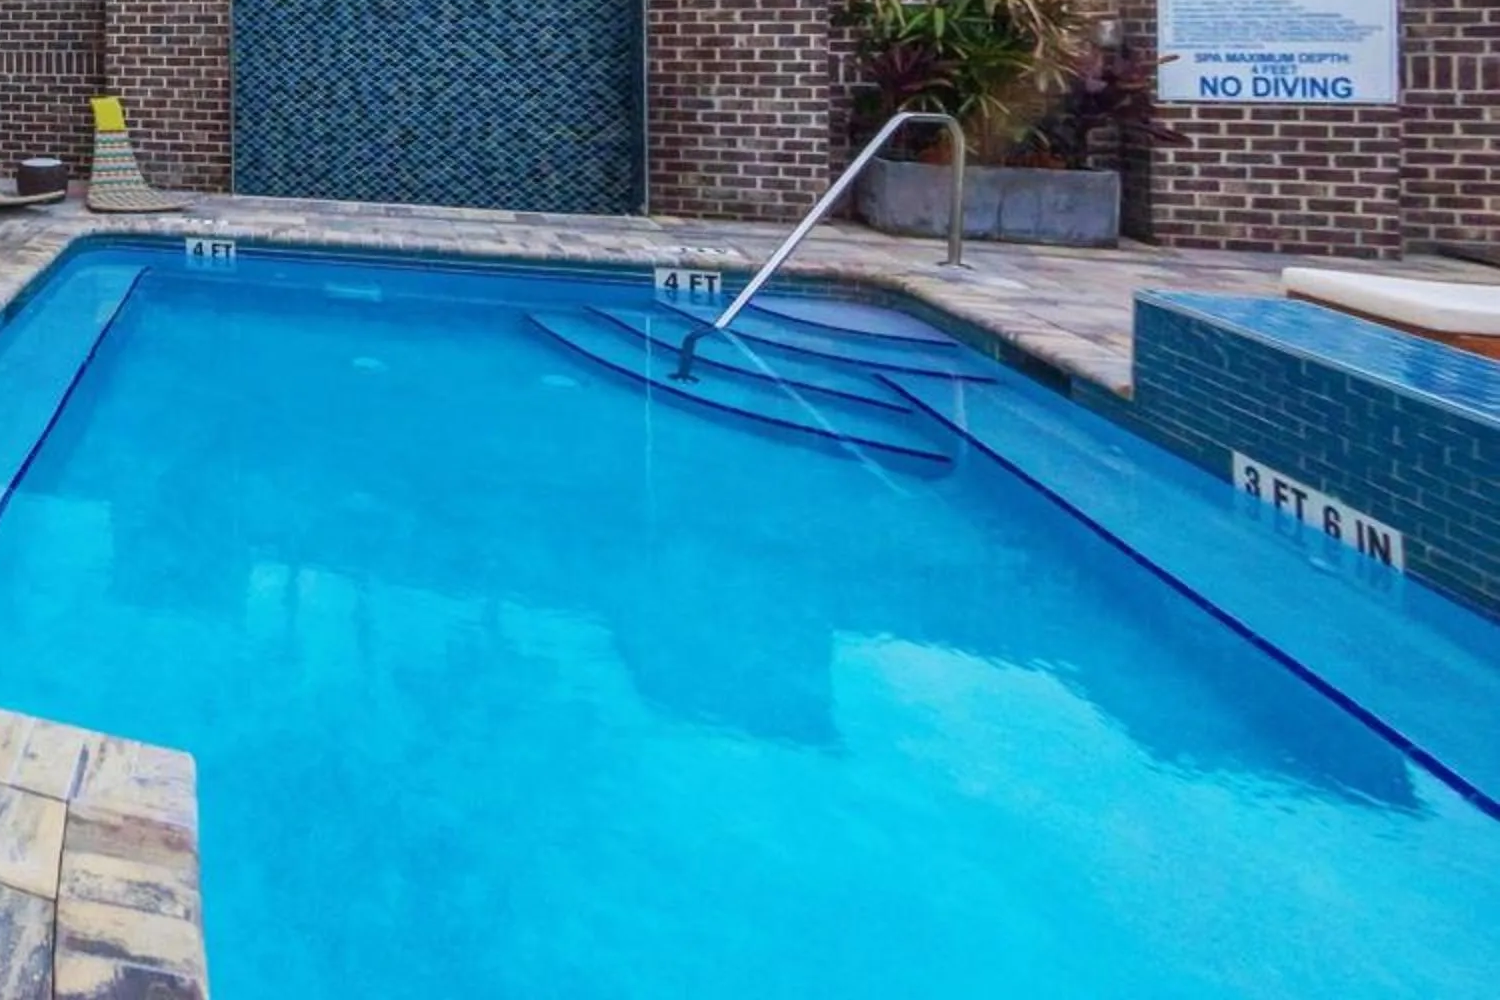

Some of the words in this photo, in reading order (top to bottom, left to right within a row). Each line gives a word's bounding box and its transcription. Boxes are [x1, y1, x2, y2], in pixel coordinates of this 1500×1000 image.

[1194, 53, 1223, 63] SPA
[1226, 53, 1295, 63] MAXIMUM
[1200, 76, 1242, 97] NO
[1253, 77, 1353, 99] DIVING
[193, 241, 204, 257] 4
[211, 243, 232, 259] FT
[663, 272, 679, 290] 4
[689, 273, 719, 293] FT
[1244, 465, 1261, 499] 3
[1272, 477, 1308, 521] FT
[1322, 504, 1342, 541] 6
[1355, 518, 1392, 567] IN
